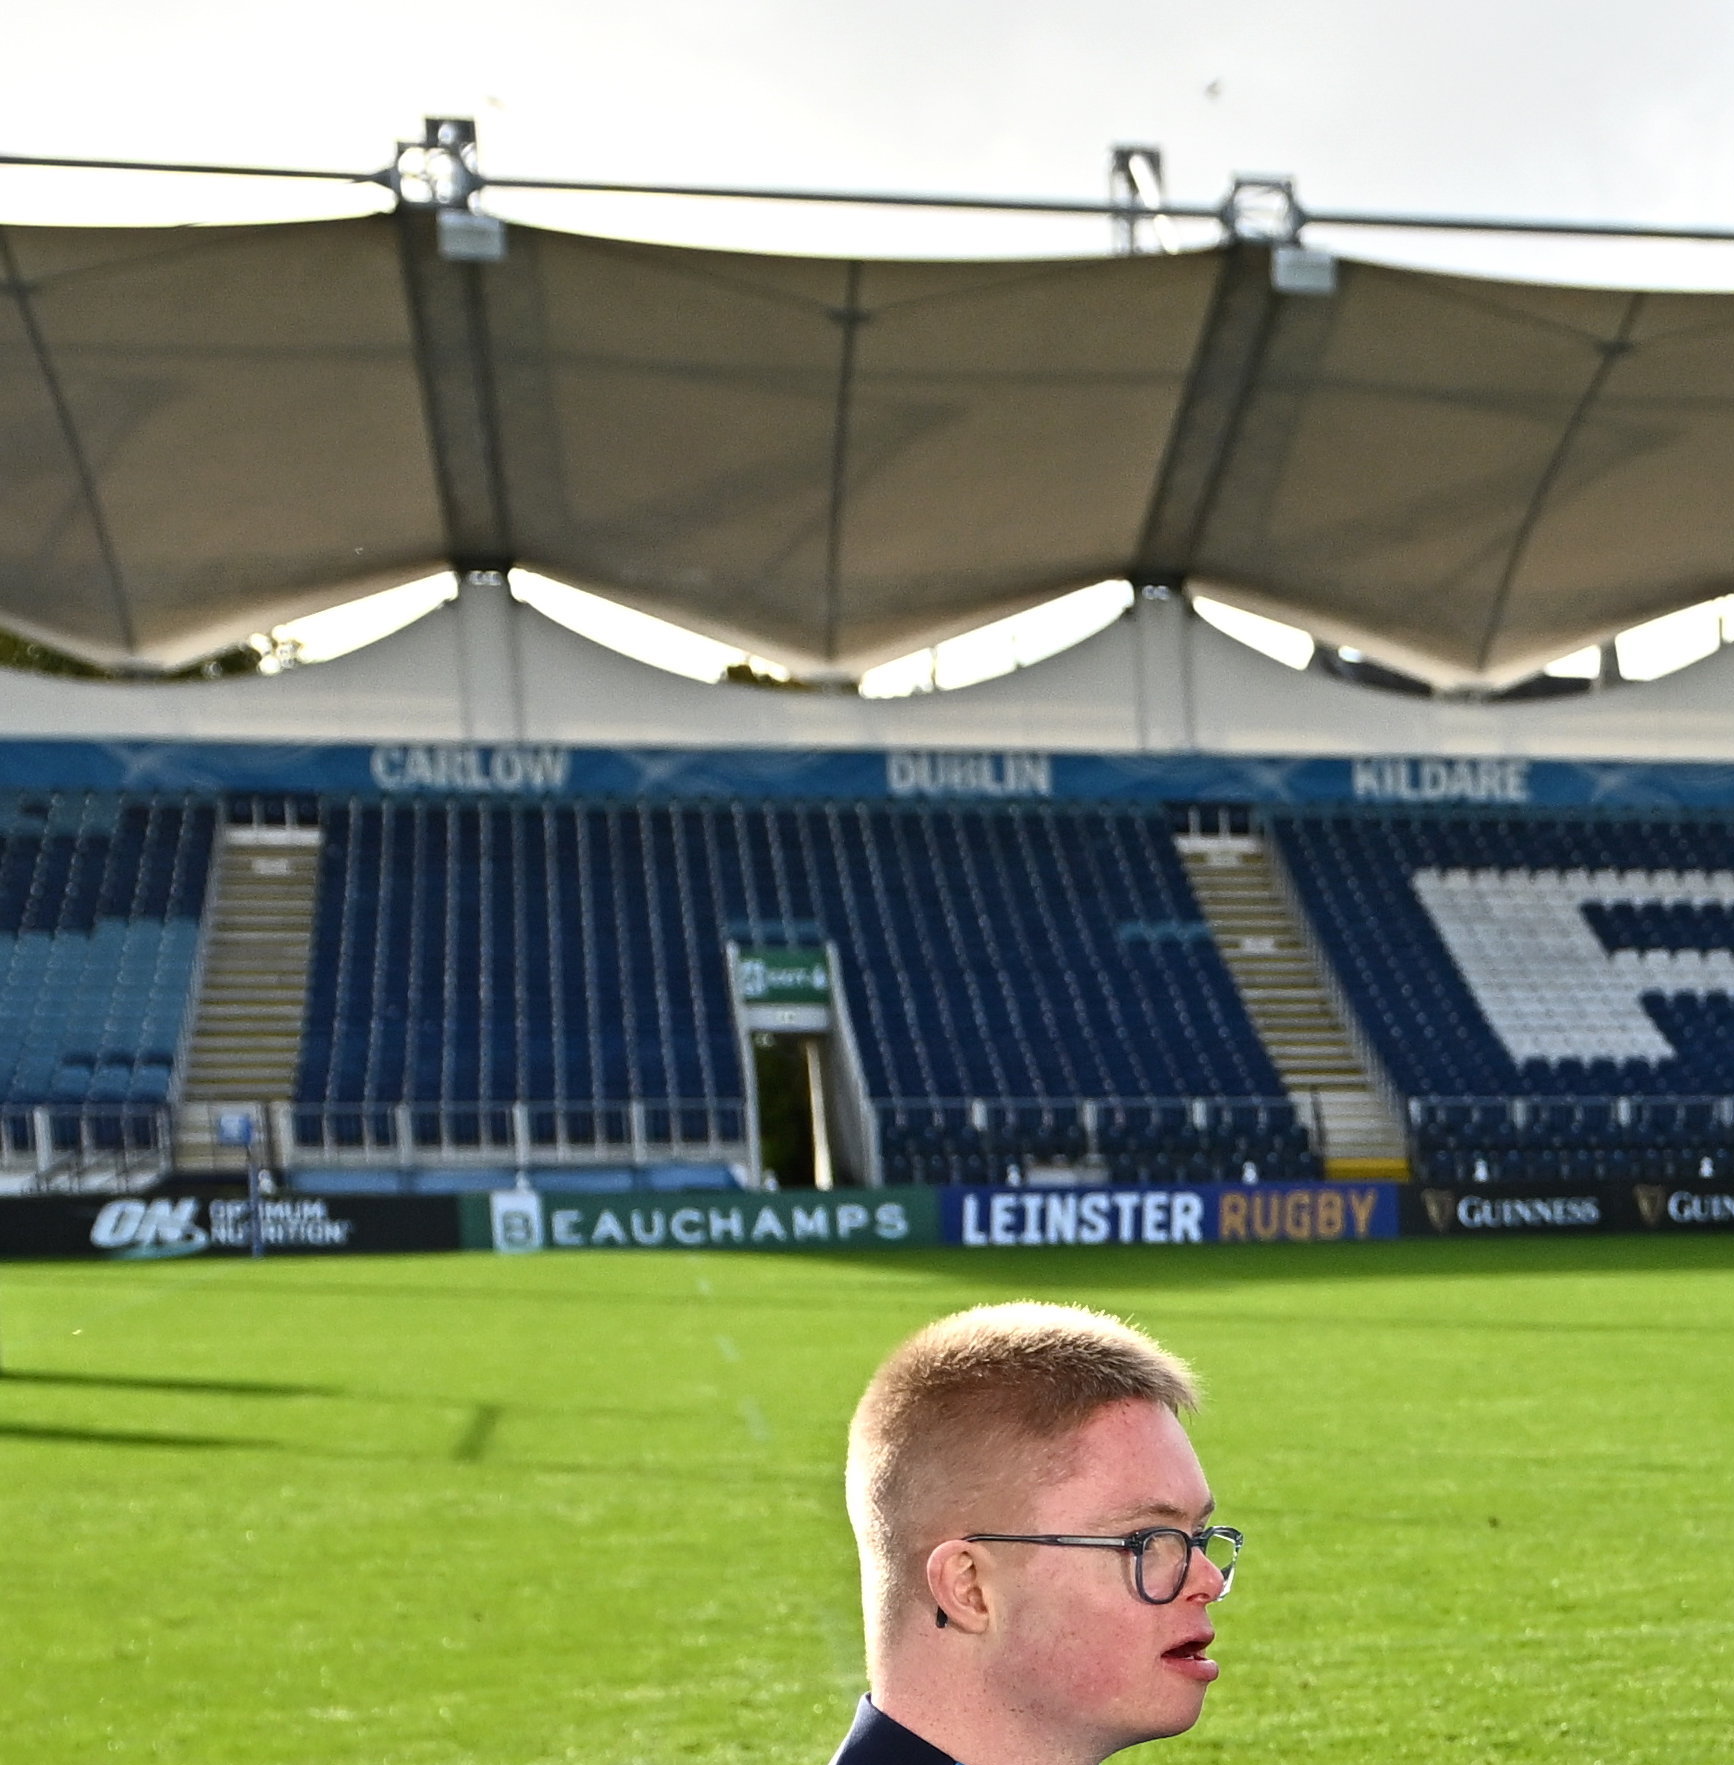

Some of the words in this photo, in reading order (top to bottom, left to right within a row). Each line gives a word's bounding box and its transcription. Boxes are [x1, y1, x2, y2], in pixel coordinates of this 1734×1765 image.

[370, 747, 570, 792] CARLOW
[886, 752, 1053, 796] DUBLIN
[1353, 758, 1530, 802] KILDARE
[211, 1221, 348, 1244] NURITION
[962, 1192, 1203, 1246] LEINSTER
[1219, 1190, 1377, 1241] RUGBY
[1457, 1196, 1599, 1227] GUINNESS
